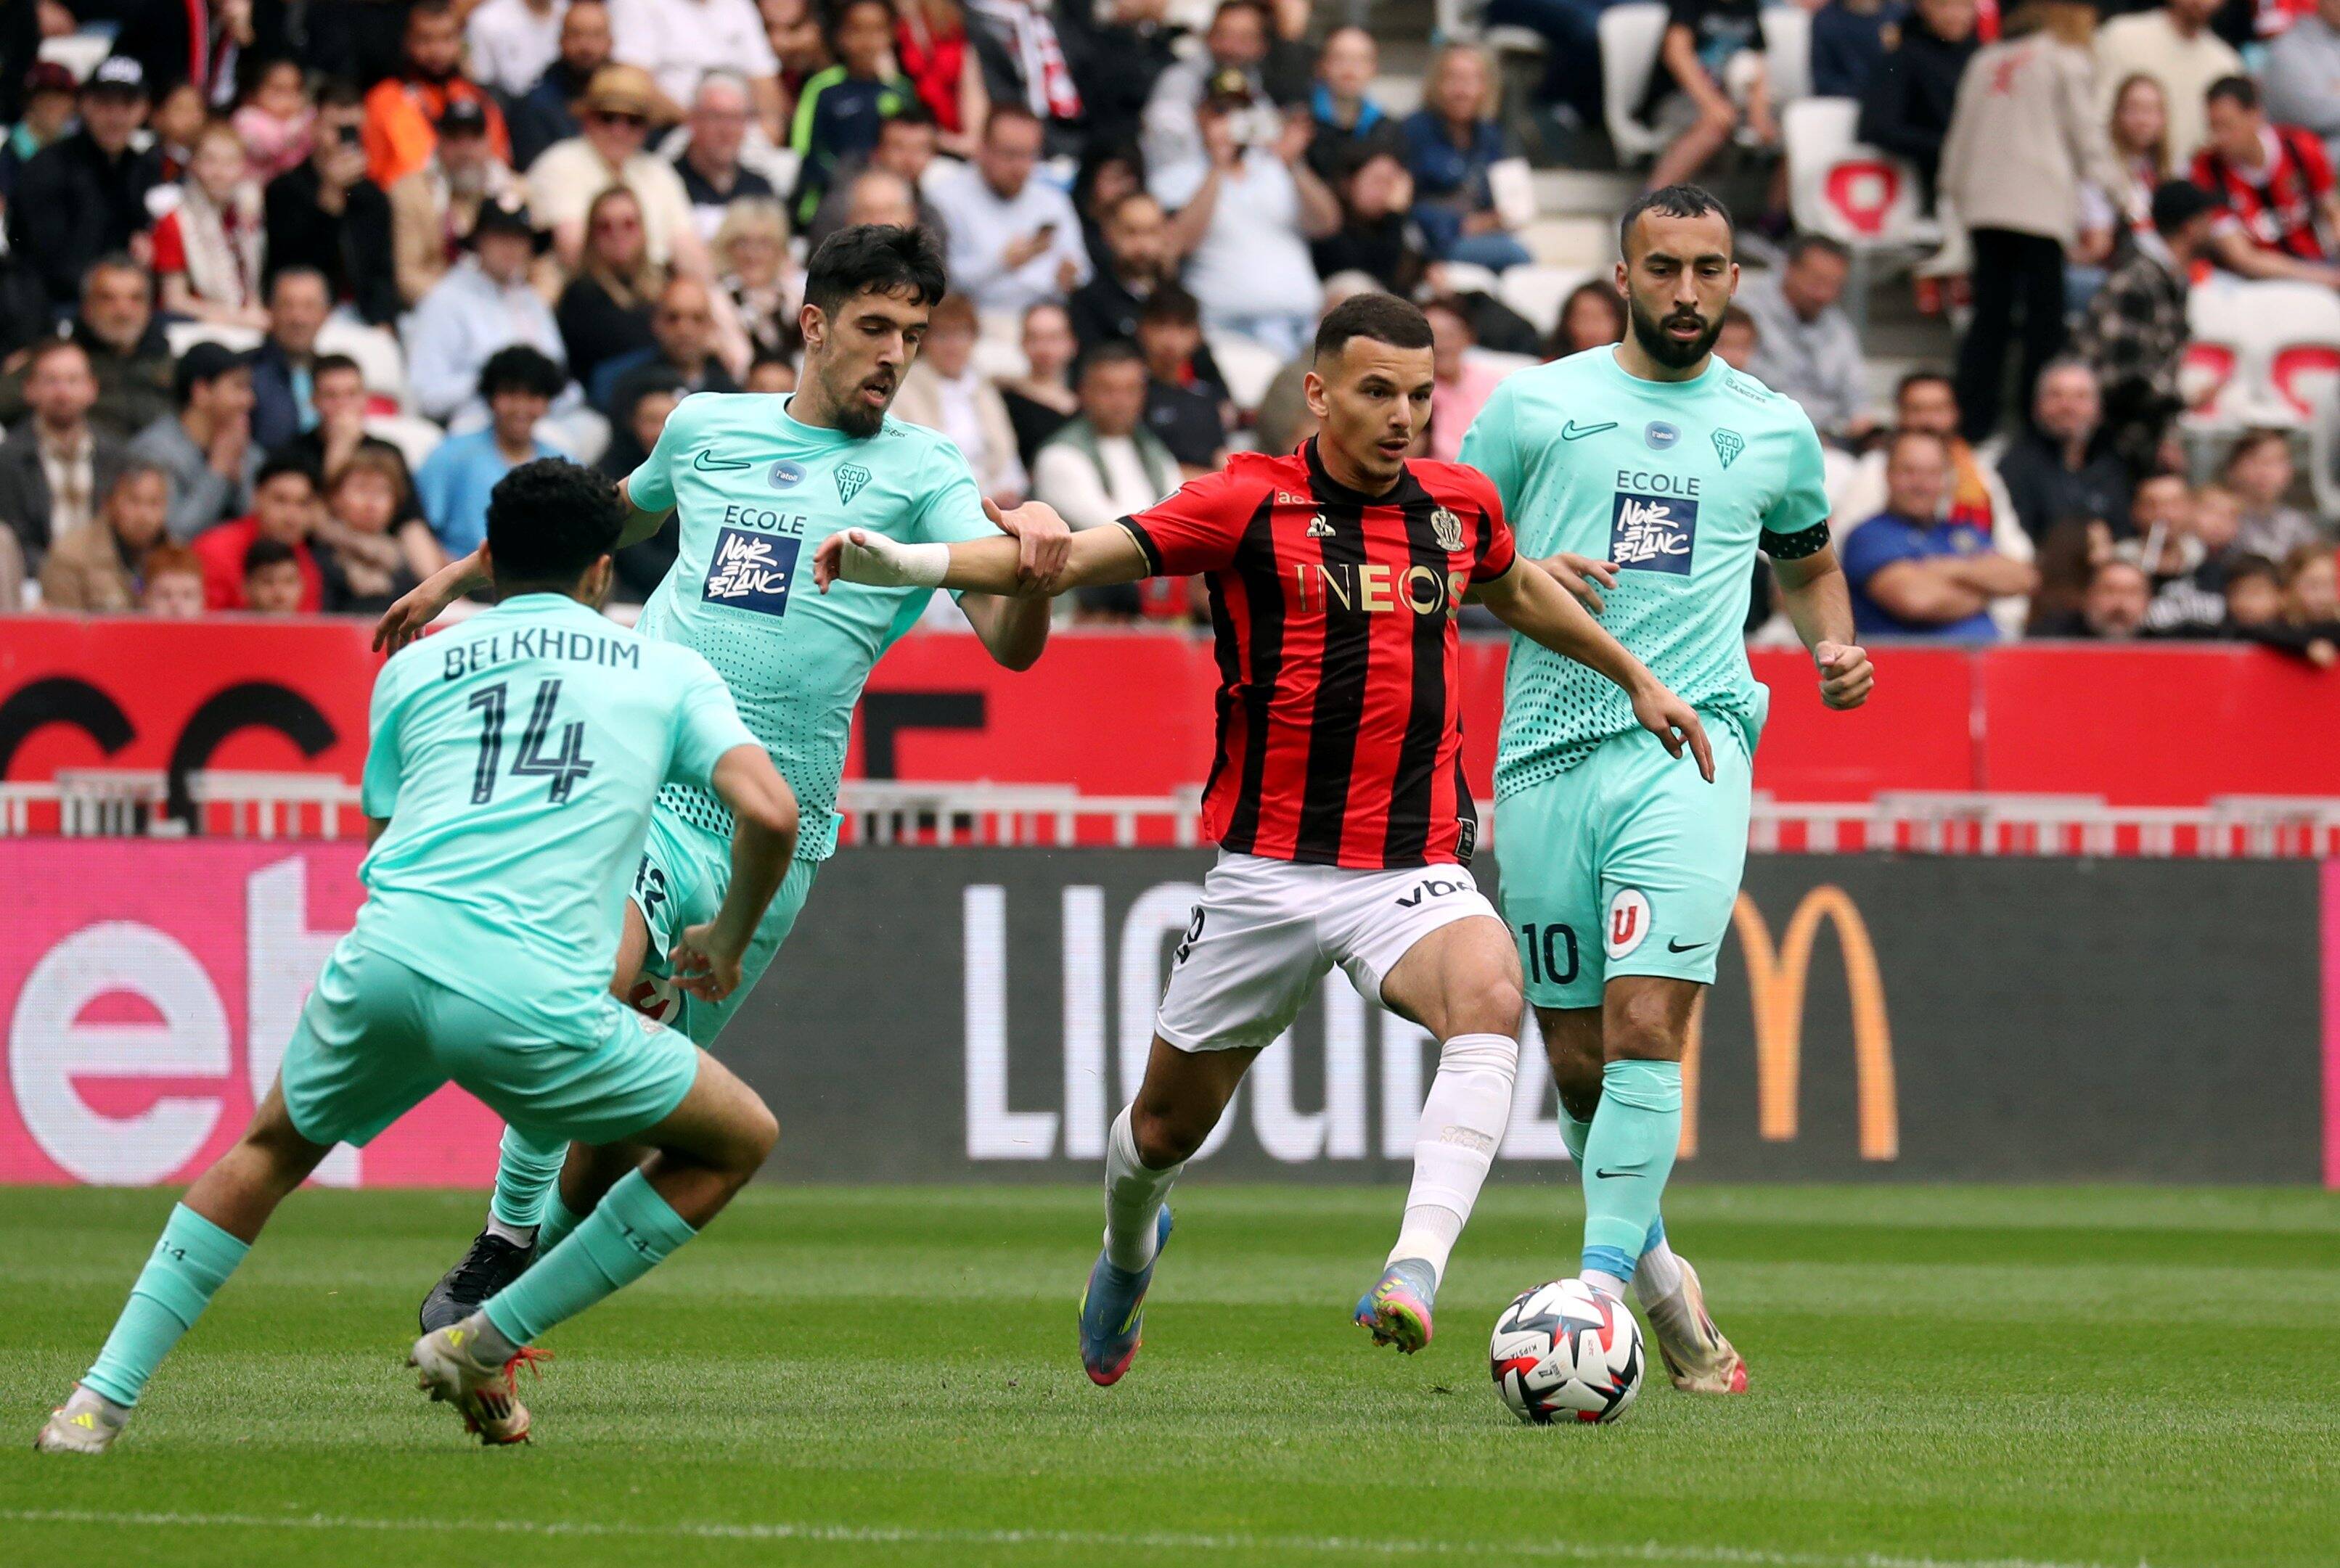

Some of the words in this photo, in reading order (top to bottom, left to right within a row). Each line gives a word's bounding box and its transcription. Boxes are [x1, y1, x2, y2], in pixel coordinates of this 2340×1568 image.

[1717, 432, 1739, 449] SCO
[840, 469, 865, 483] SCO
[1617, 470, 1701, 496] ECOLE
[724, 504, 807, 535] ECOLE
[1294, 564, 1465, 620] INEOS
[443, 627, 639, 681] BELKHDIM
[467, 679, 596, 805] 14
[1613, 906, 1638, 945] U
[1521, 922, 1580, 985] 10
